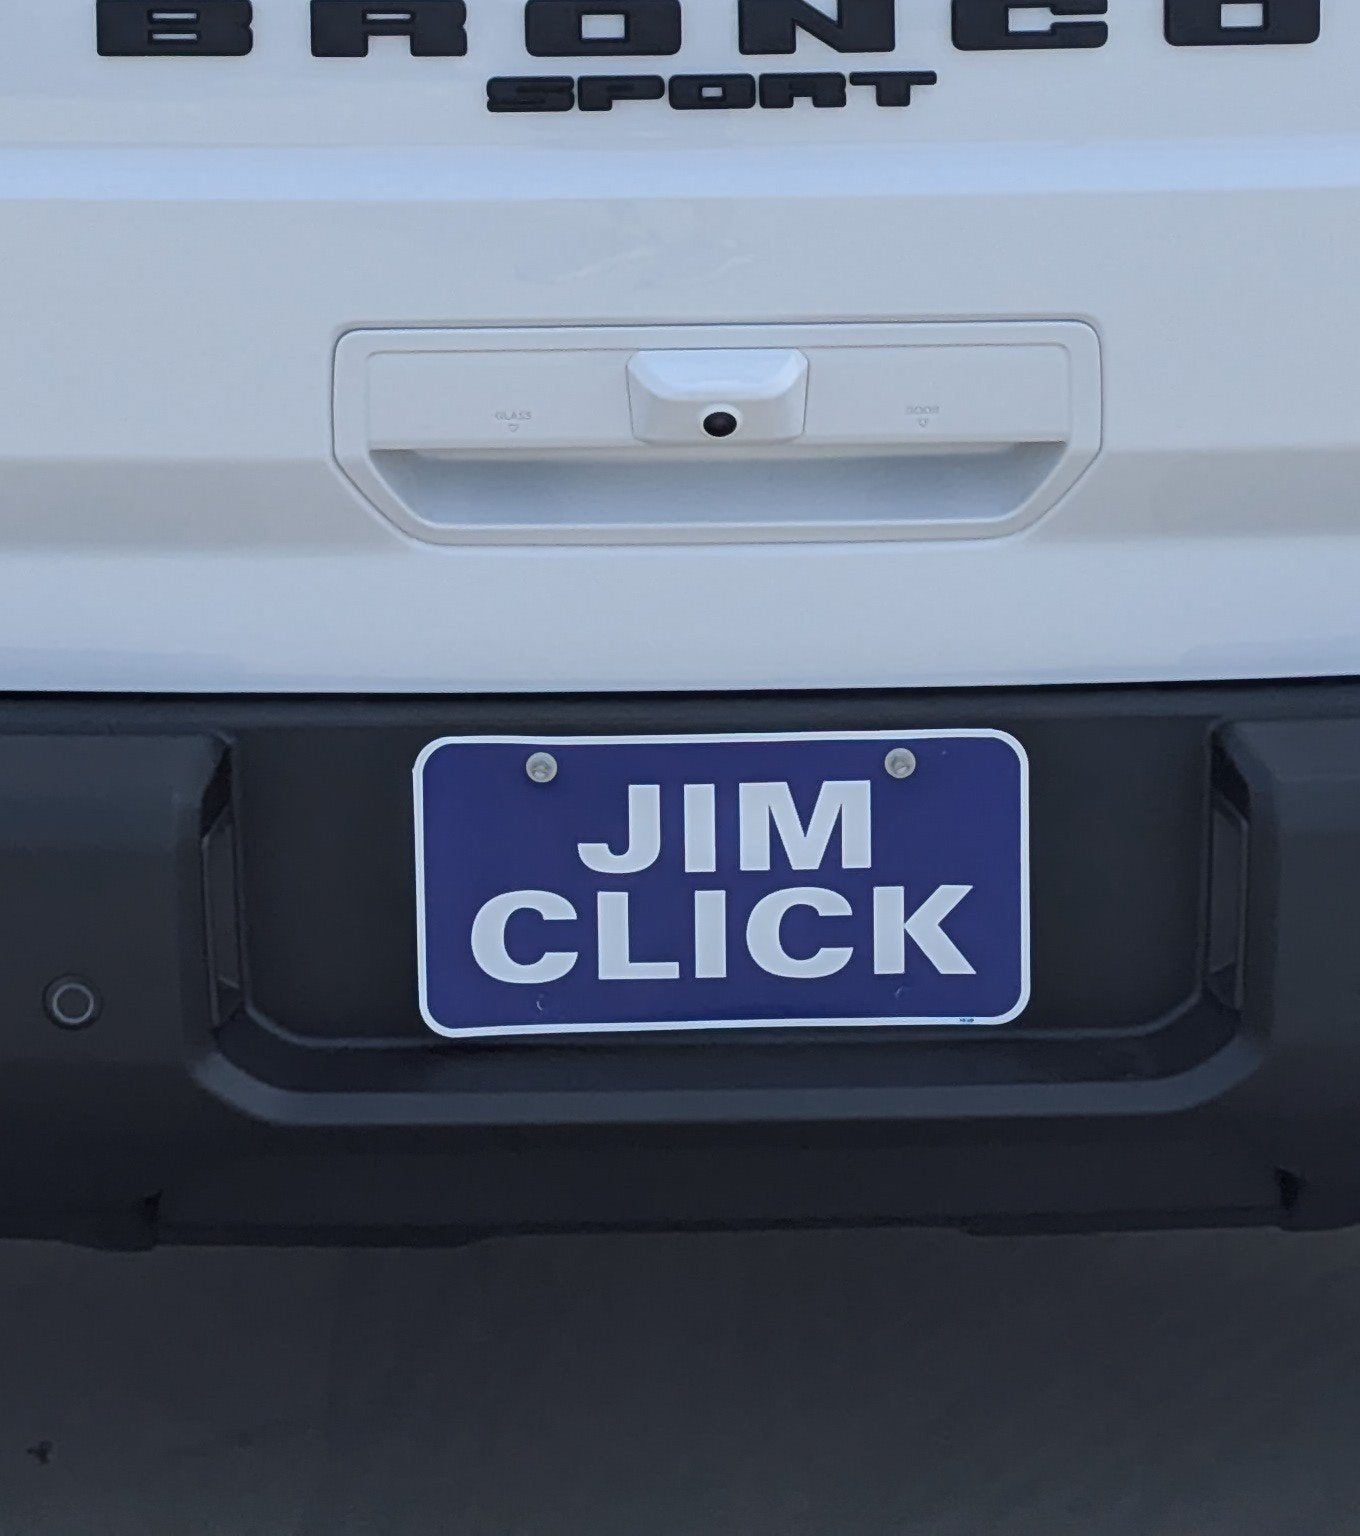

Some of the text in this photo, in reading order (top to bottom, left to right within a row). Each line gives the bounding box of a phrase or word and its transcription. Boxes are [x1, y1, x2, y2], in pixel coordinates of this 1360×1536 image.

[486, 70, 937, 112] SPORT
[577, 780, 872, 874] JIM
[470, 884, 977, 984] CLICK
